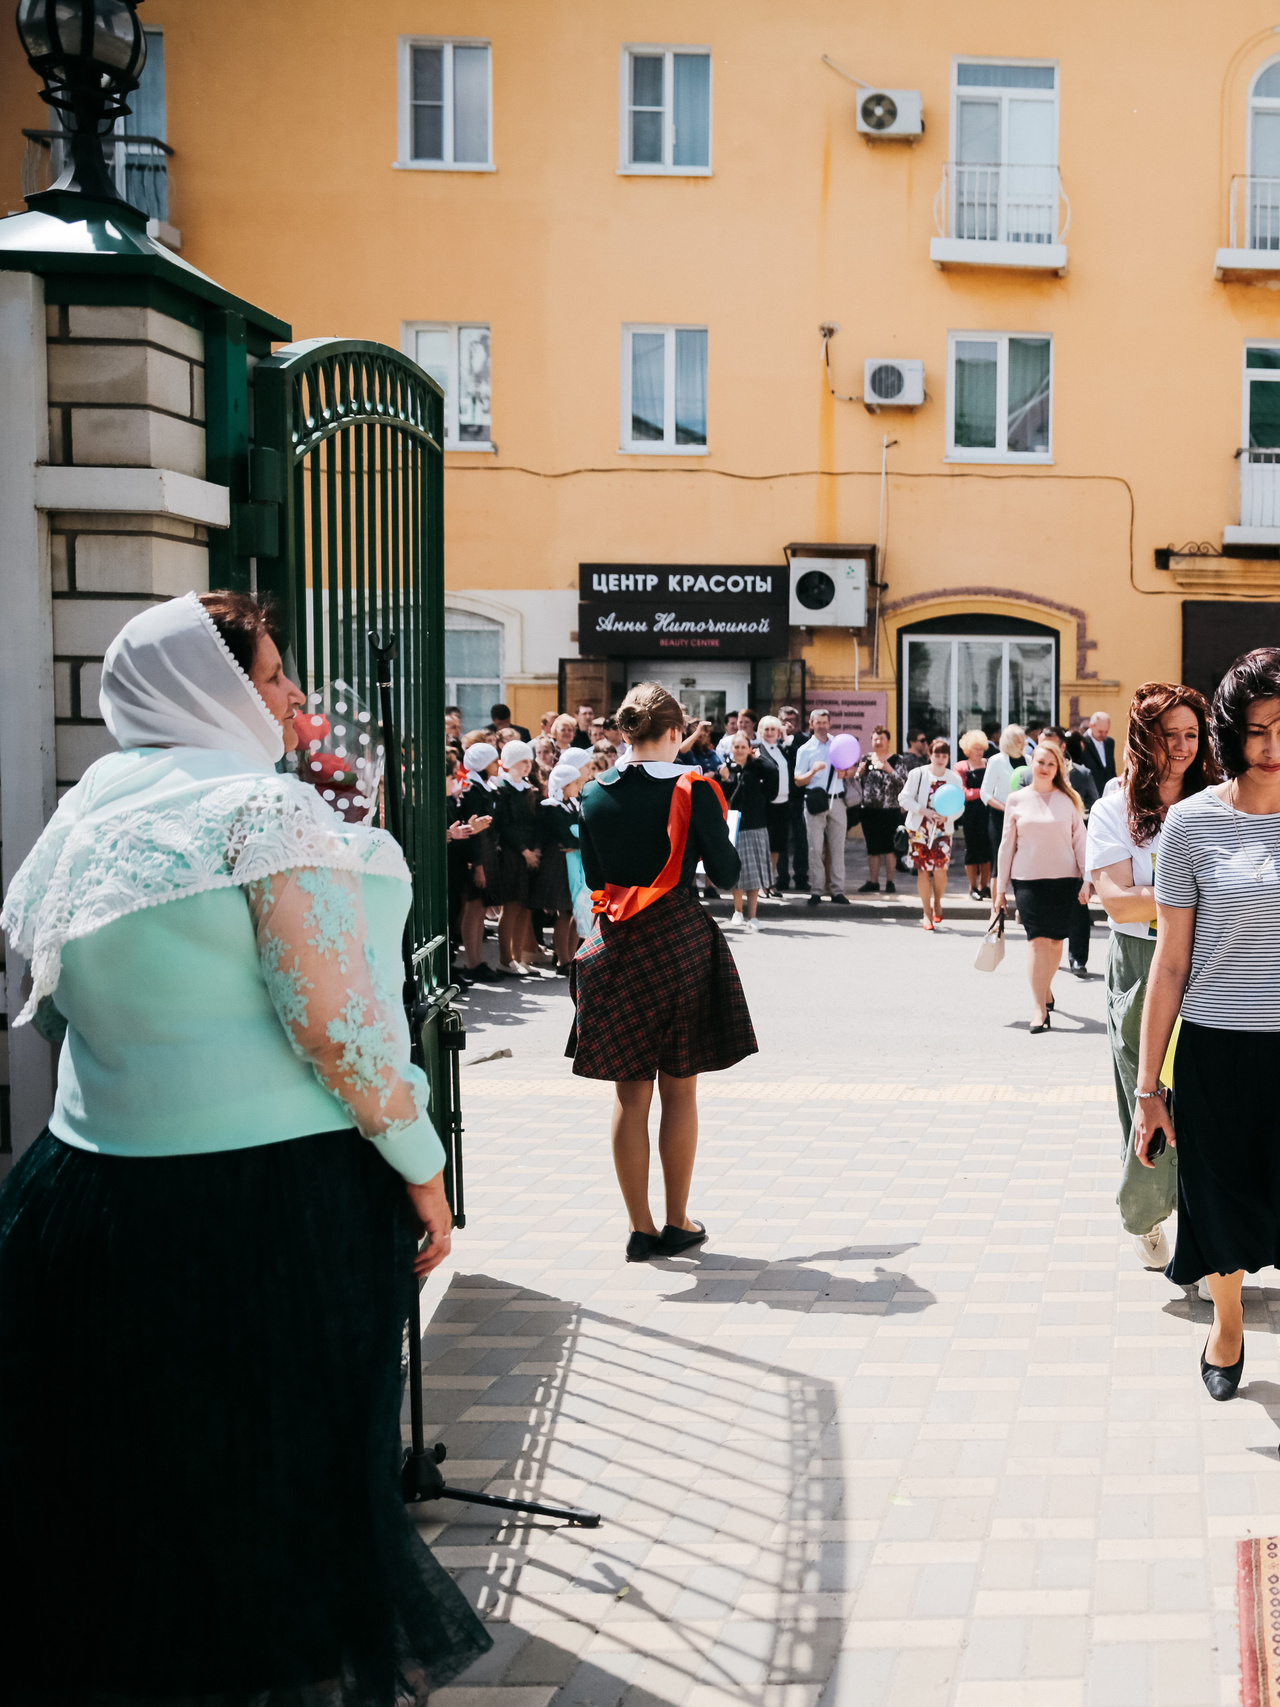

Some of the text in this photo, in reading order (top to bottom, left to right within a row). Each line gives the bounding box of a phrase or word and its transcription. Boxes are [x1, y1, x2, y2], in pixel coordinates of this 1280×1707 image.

[592, 573, 773, 594] ЦЕНТР КРАСОТЫ
[596, 612, 770, 633] Анны Ниточкиной
[660, 639, 720, 647] BEAUTY CENTRE
